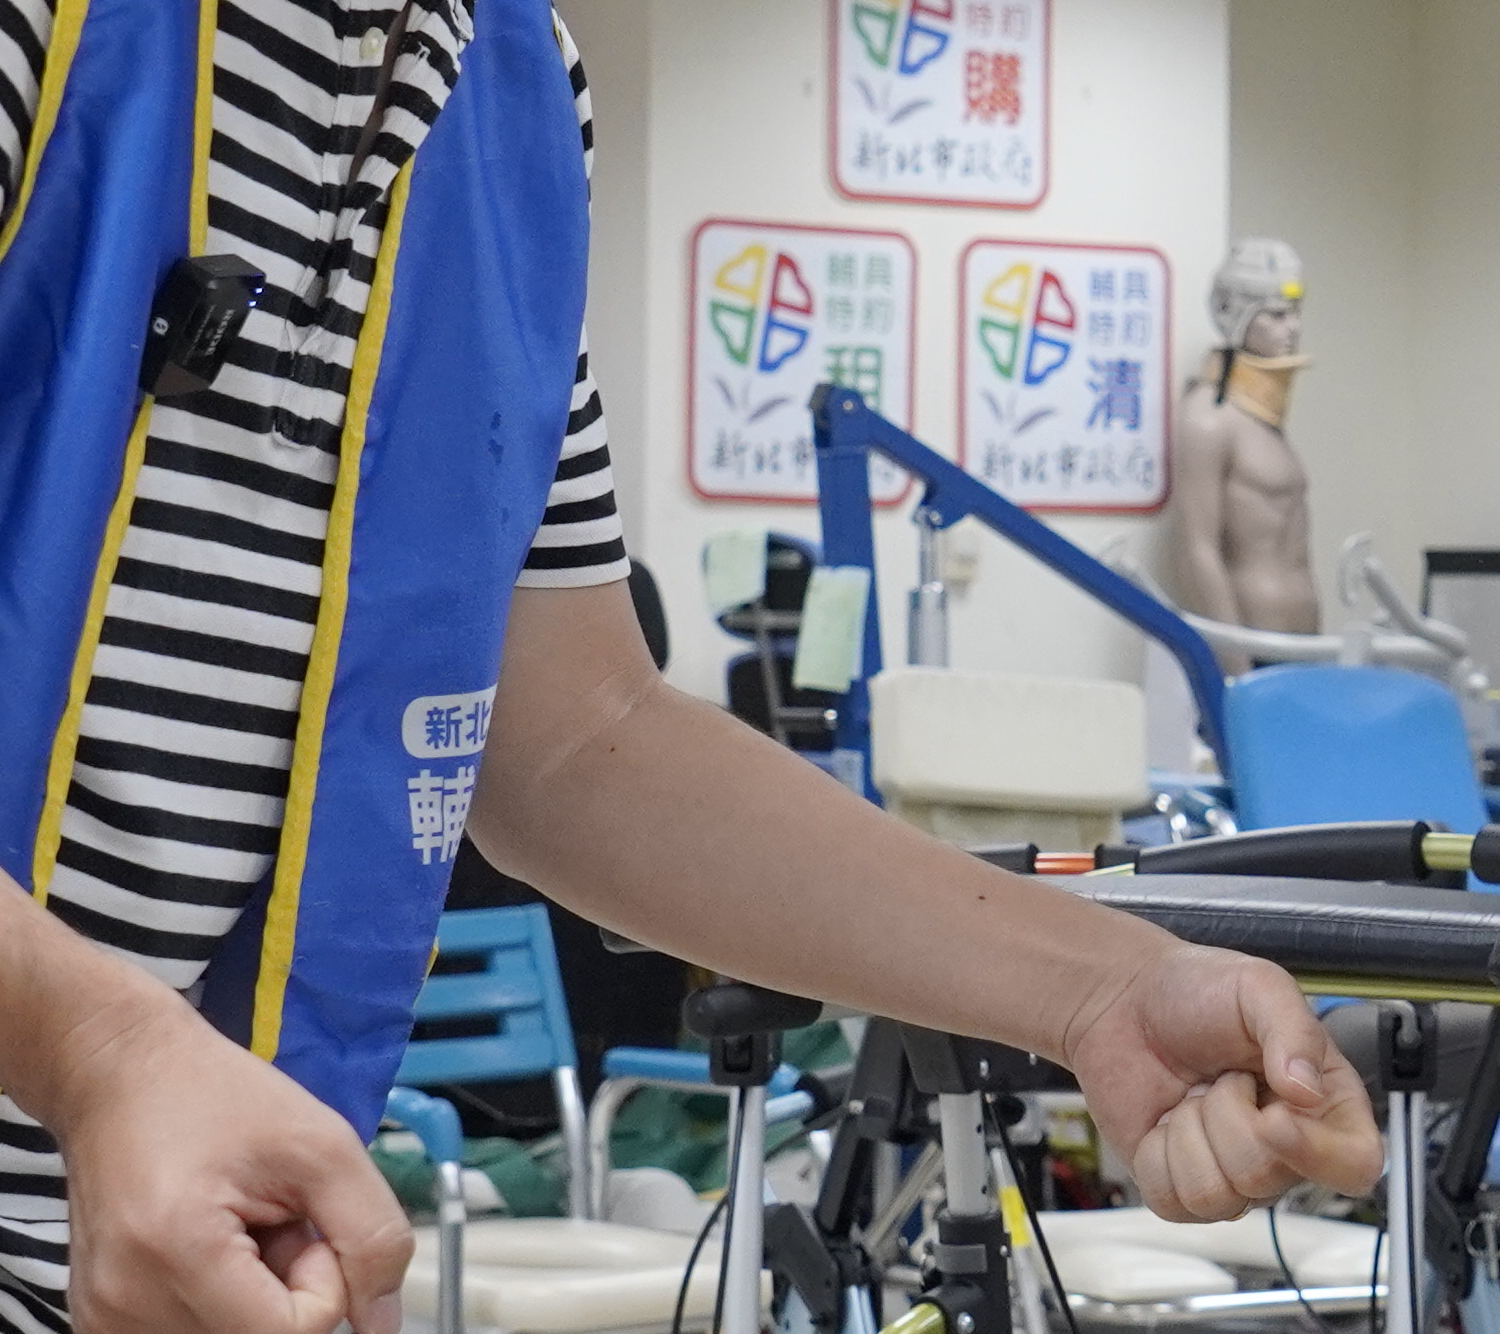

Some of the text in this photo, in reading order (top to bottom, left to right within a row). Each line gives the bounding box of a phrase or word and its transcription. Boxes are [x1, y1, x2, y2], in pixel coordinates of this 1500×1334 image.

[964, 50, 1020, 125] 購
[853, 131, 1032, 185] 新北市政府
[826, 253, 892, 286] 輔具
[1088, 270, 1149, 301] 輔具
[983, 443, 1154, 491] 新北市政府
[425, 700, 492, 749] 新北
